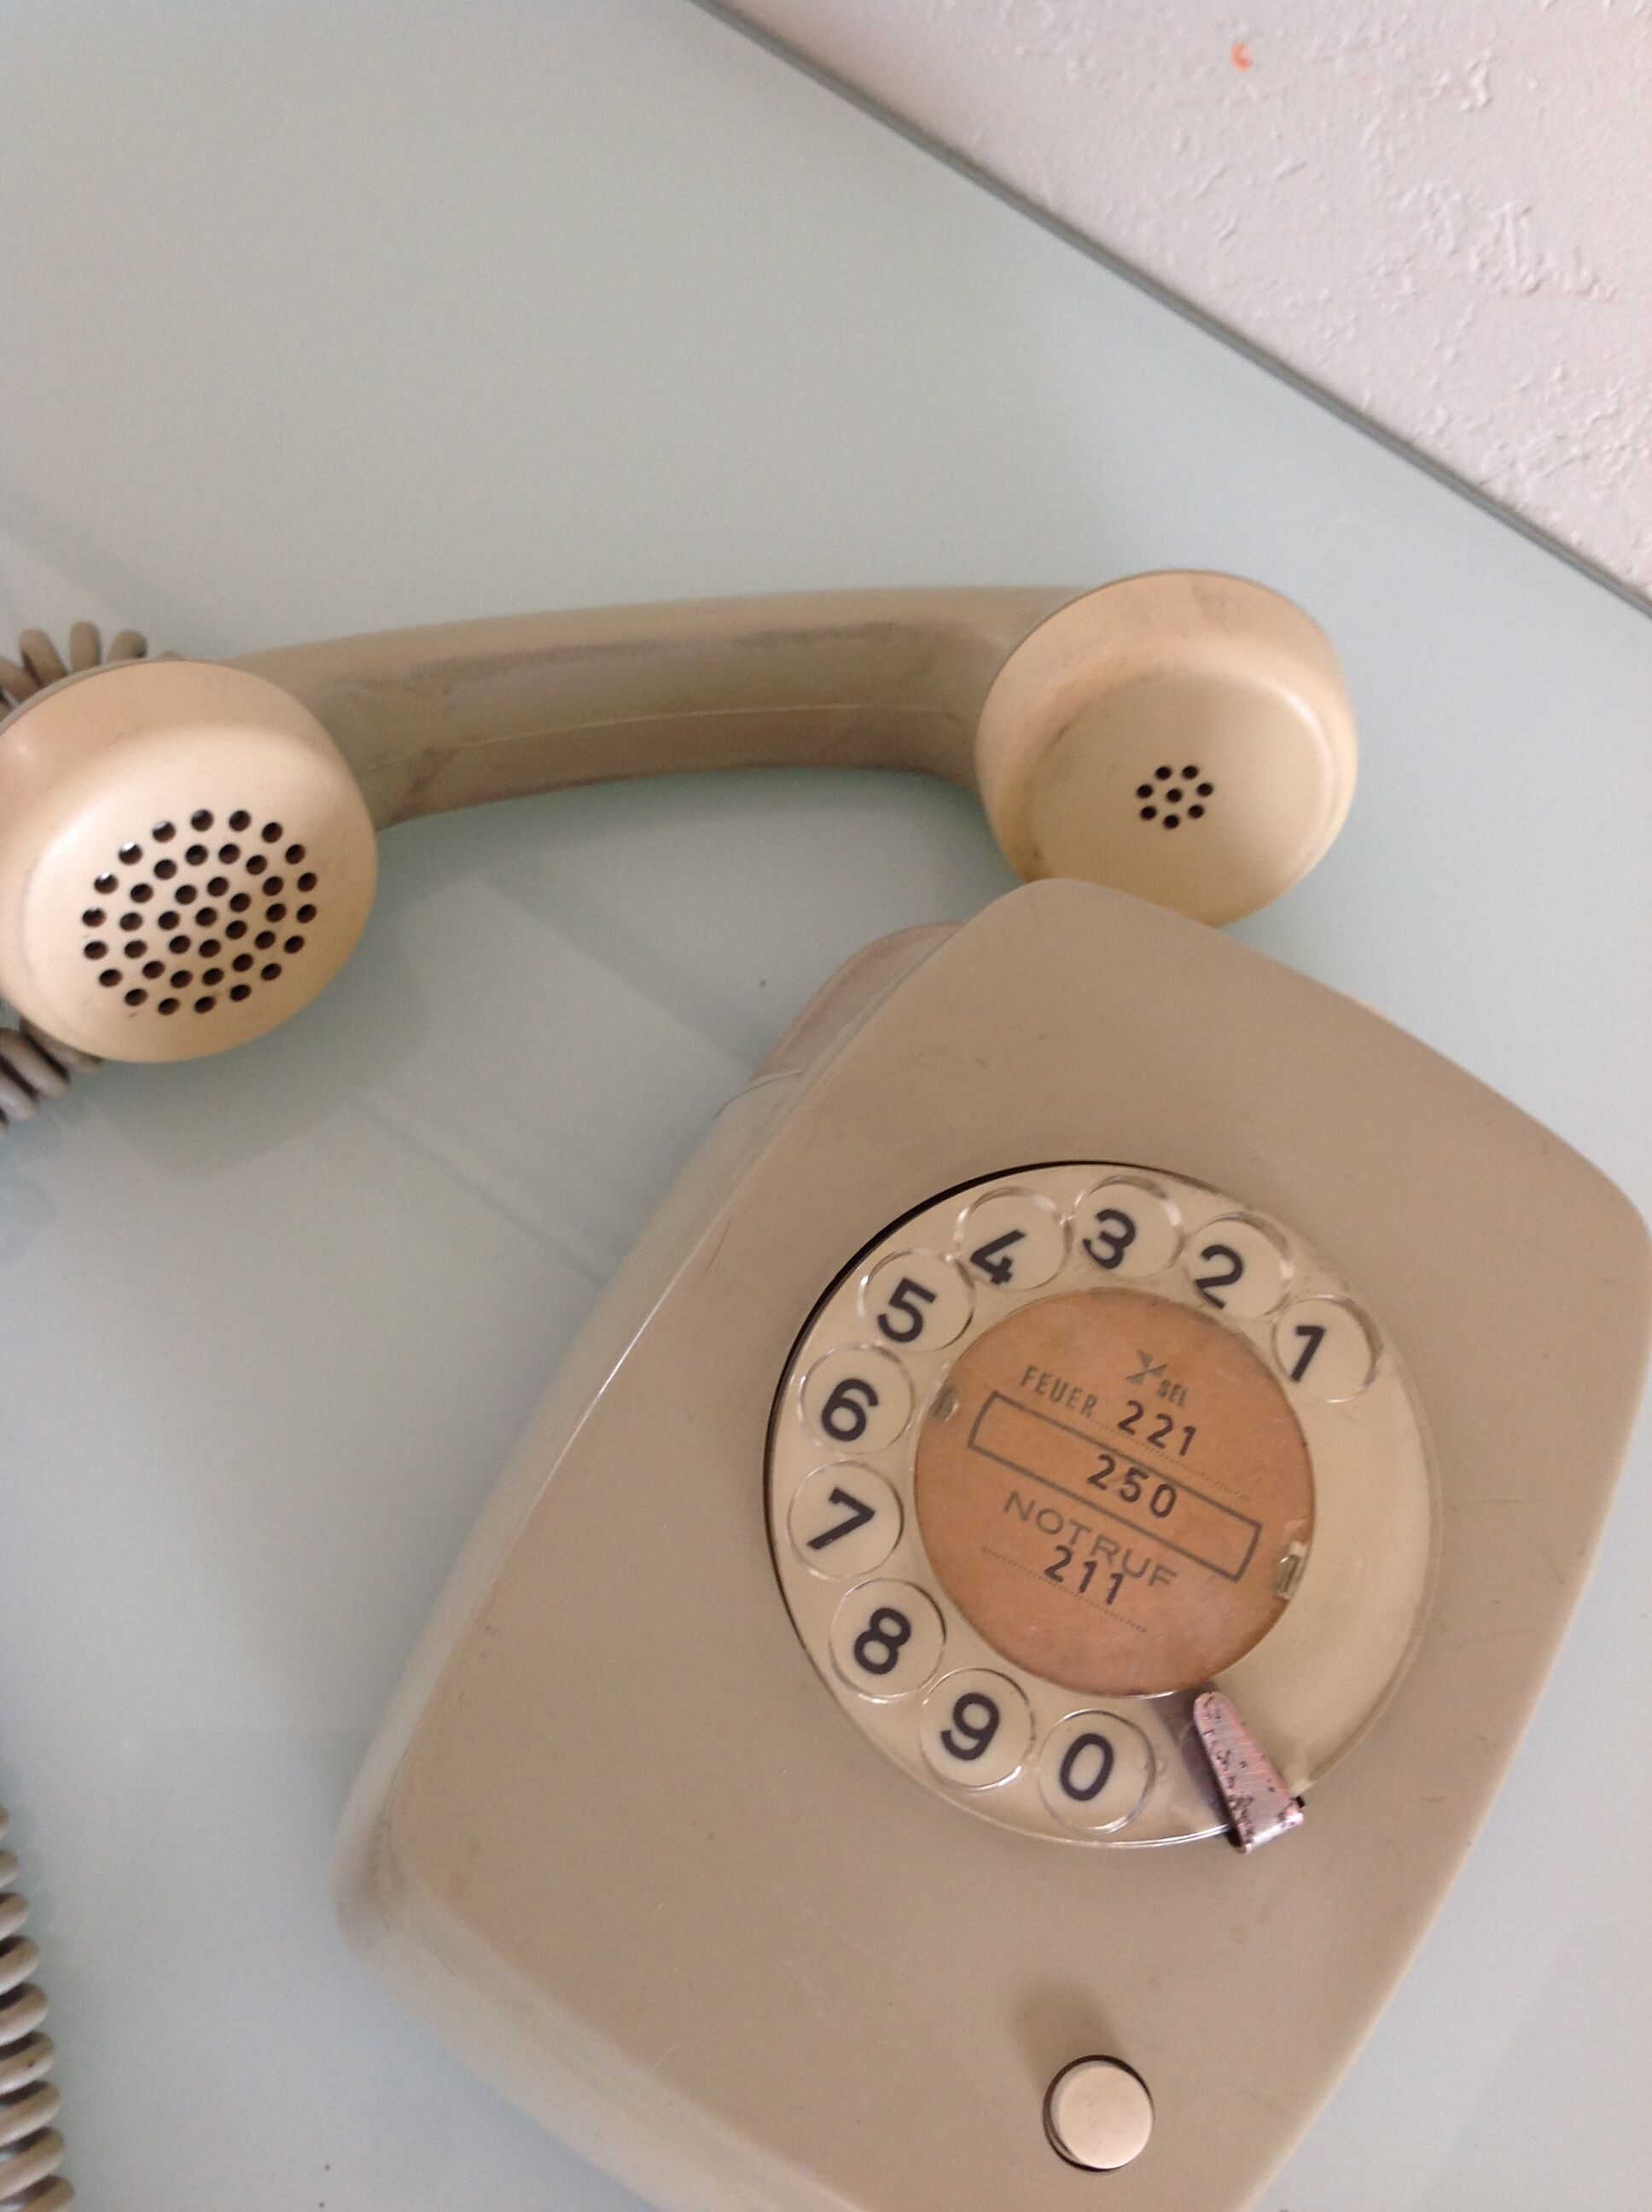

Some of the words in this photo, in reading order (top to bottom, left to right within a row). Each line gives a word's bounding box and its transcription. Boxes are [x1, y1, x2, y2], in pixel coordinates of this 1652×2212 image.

[969, 1229, 1026, 1286] 4
[1083, 1208, 1136, 1270] 3
[1194, 1243, 1245, 1310] 2
[876, 1277, 937, 1343] 5
[1289, 1324, 1326, 1382] 1
[820, 1377, 879, 1442] 6
[1019, 1364, 1099, 1420] FEUER
[1117, 1400, 1197, 1457] 221
[806, 1487, 875, 1551] 7
[1085, 1453, 1178, 1519] 250
[1003, 1489, 1178, 1588] NOTRUF
[1043, 1545, 1126, 1606] 211
[852, 1606, 912, 1676] 8
[939, 1691, 1001, 1761] 9
[1059, 1732, 1114, 1802] 0
